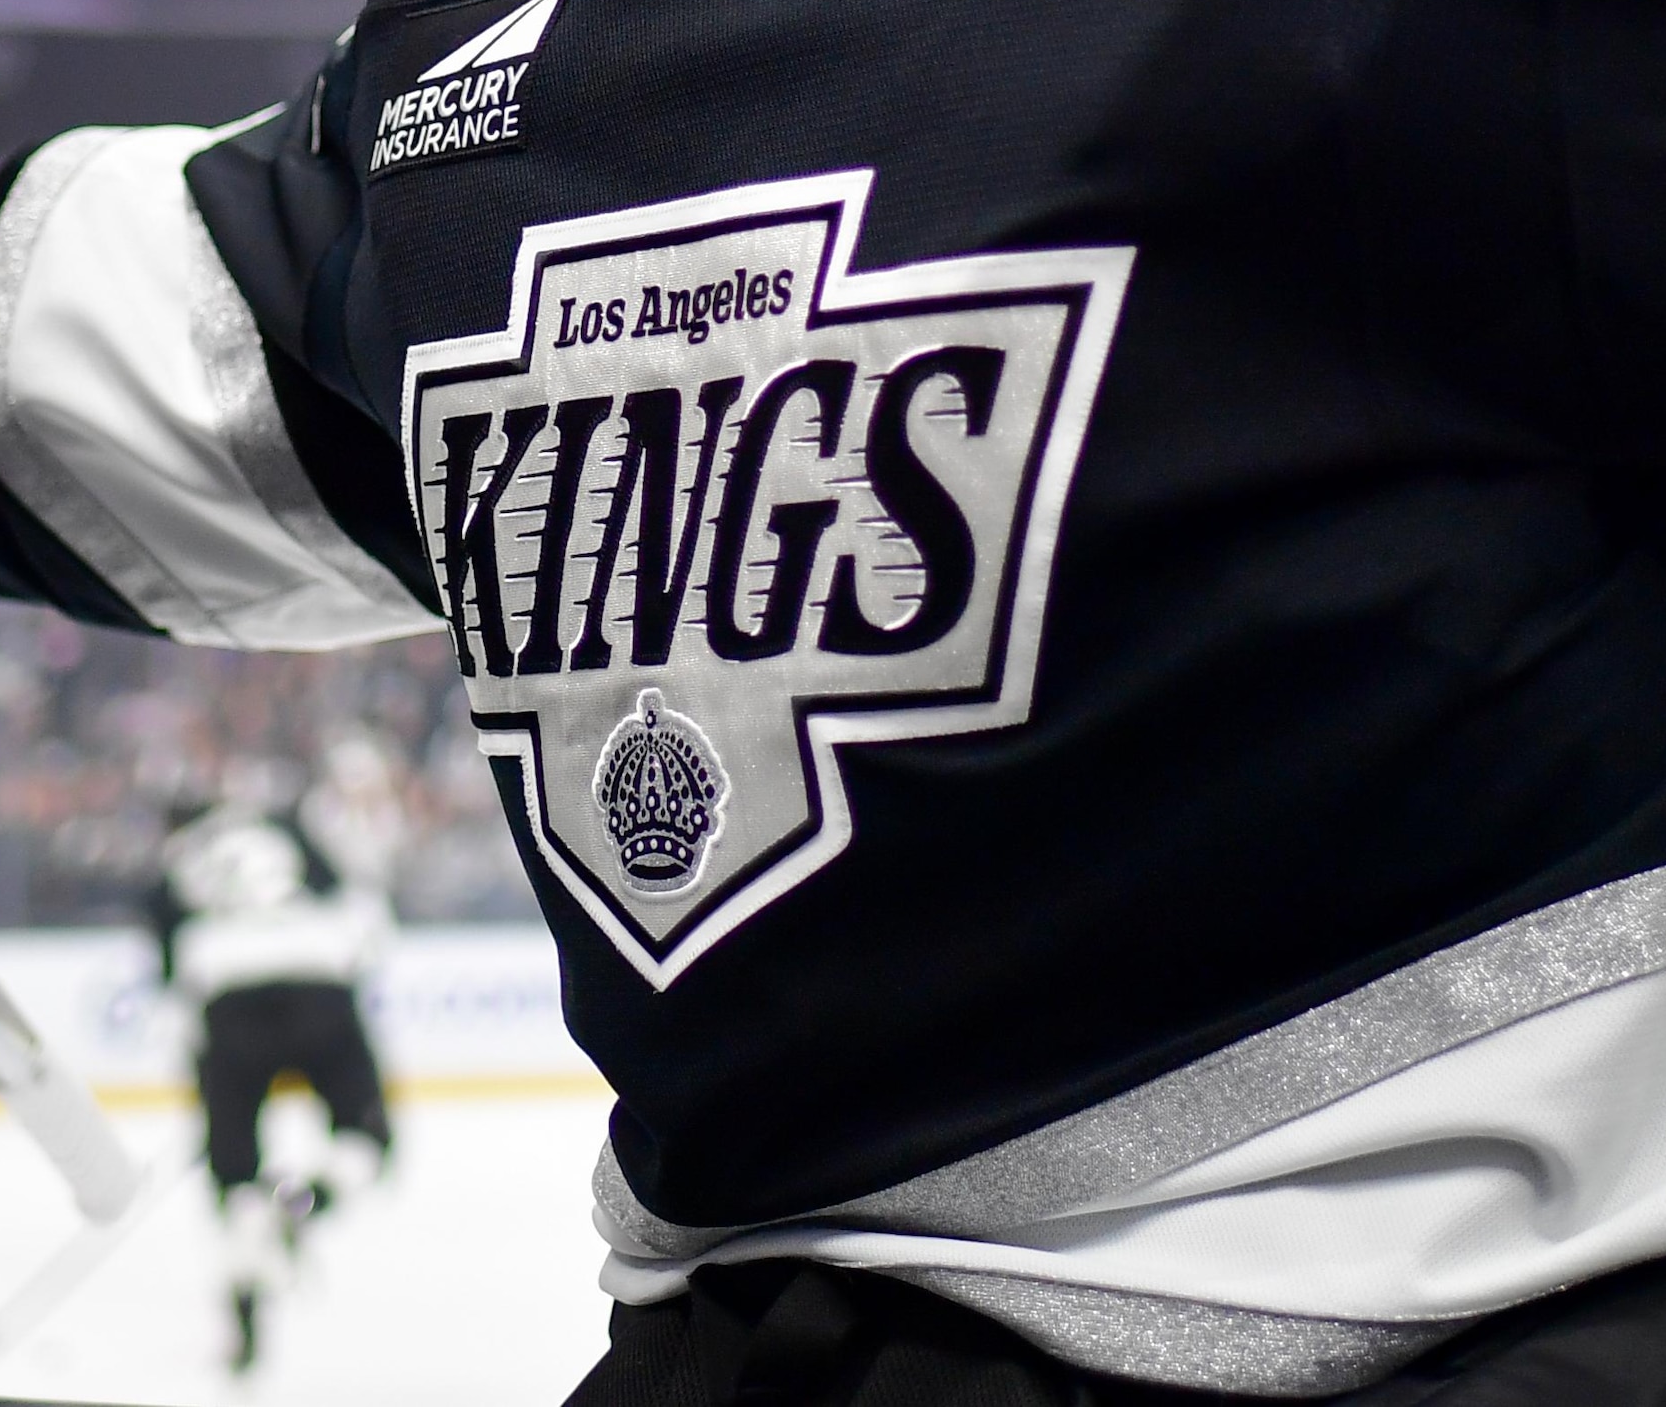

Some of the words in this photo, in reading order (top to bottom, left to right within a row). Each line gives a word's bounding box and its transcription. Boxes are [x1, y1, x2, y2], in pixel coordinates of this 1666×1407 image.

[369, 104, 521, 172] INSURANCE
[377, 61, 530, 137] MERCURY
[553, 297, 625, 349] Los
[631, 268, 794, 345] Angeles
[425, 344, 1007, 679] KINGS
